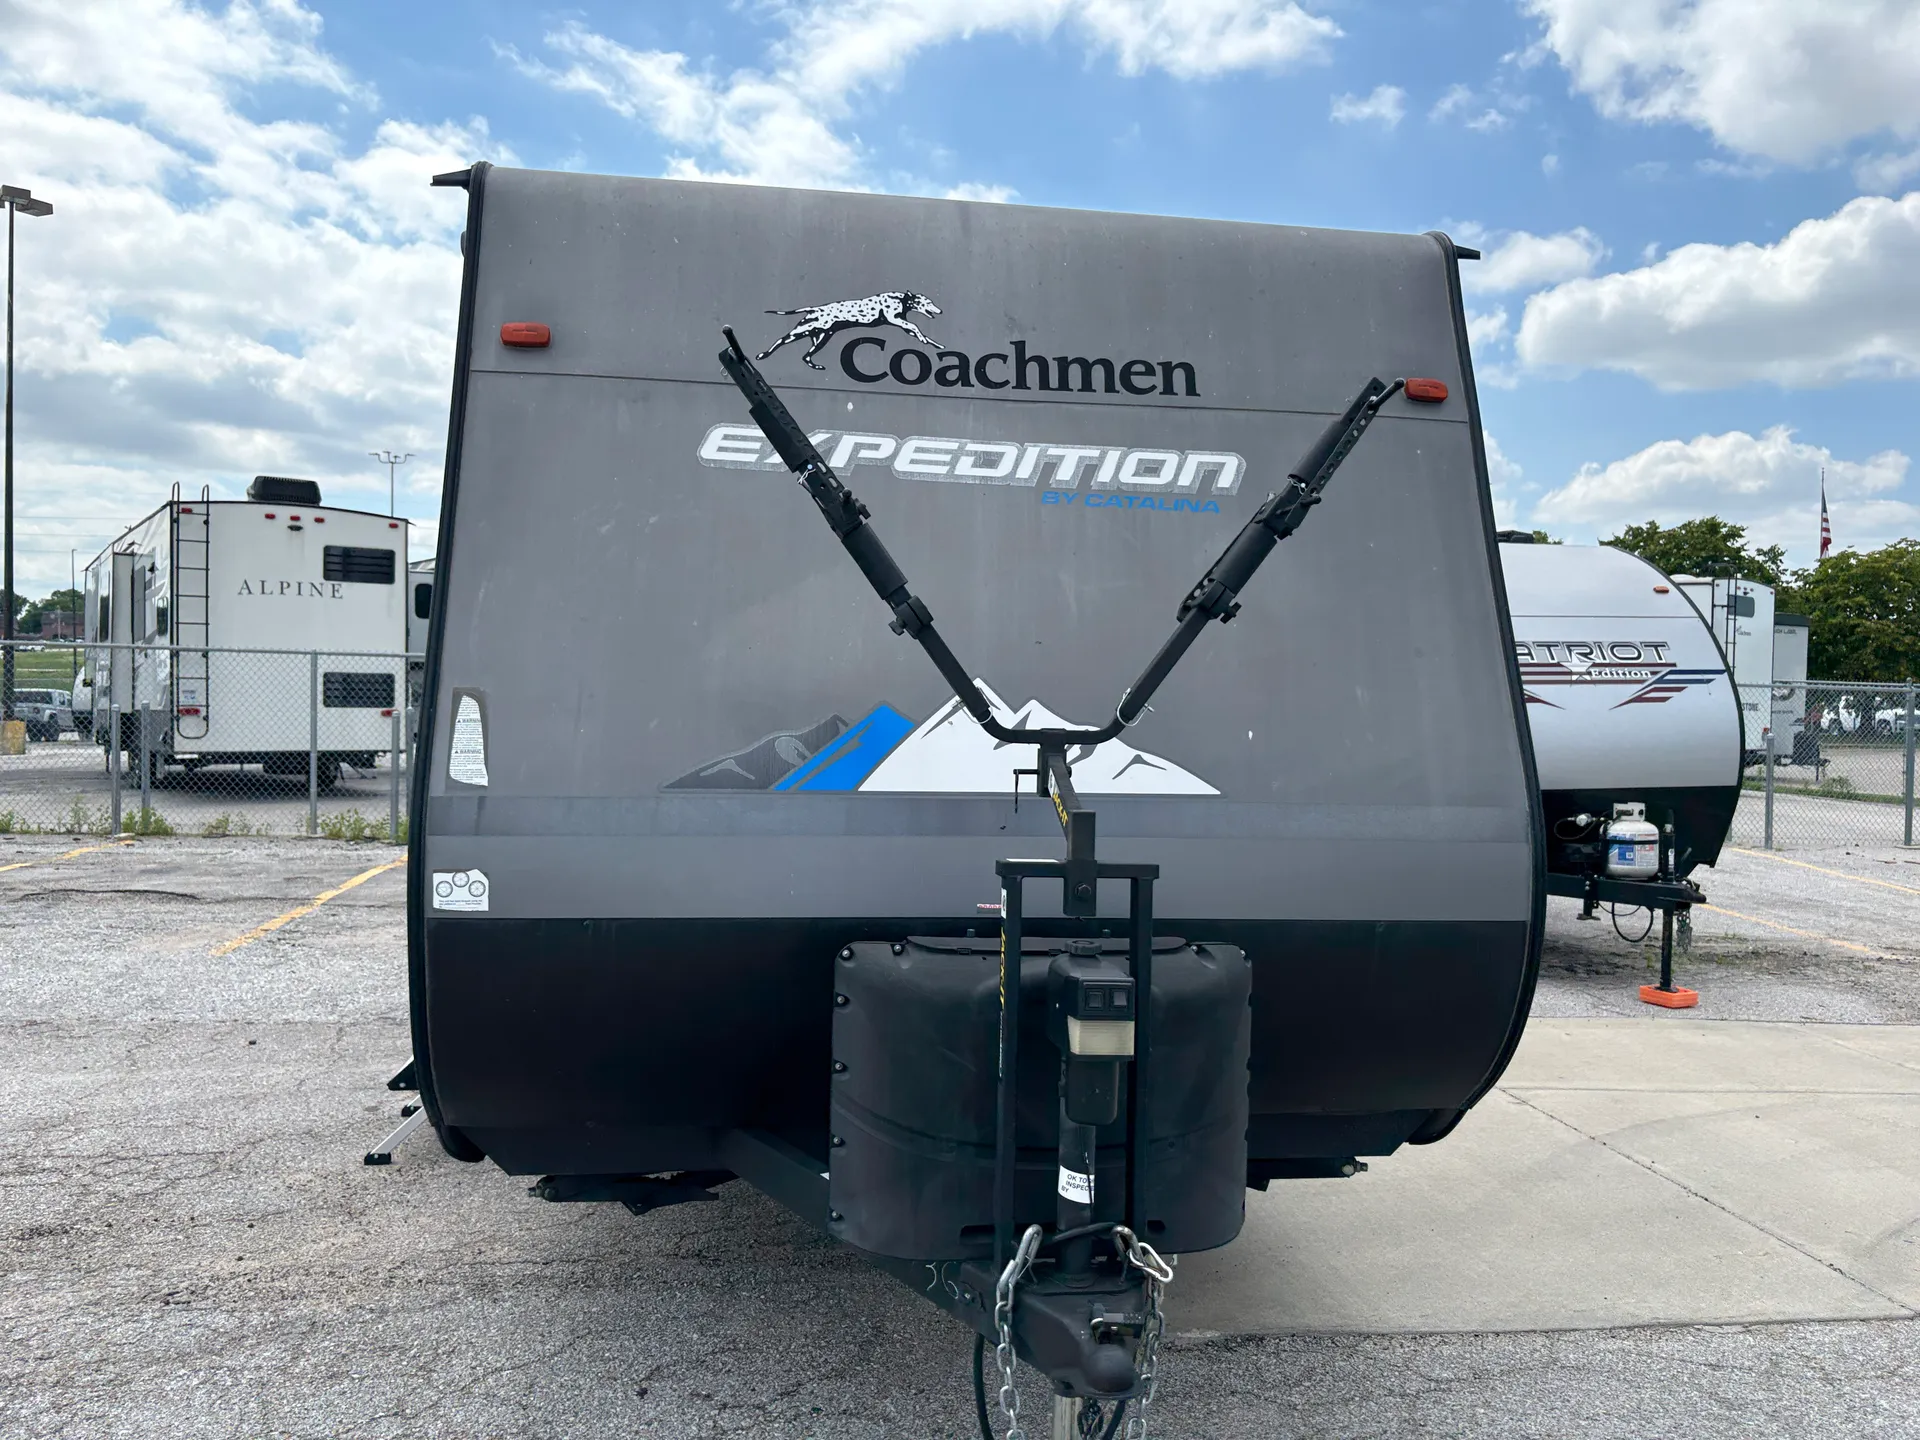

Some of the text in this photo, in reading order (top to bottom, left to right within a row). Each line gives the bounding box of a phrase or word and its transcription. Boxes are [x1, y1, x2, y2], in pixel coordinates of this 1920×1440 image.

[840, 337, 1200, 397] Coachmen
[1041, 491, 1221, 514] BY CATALINA
[237, 578, 344, 600] ALPINE
[1591, 667, 1651, 679] Edition
